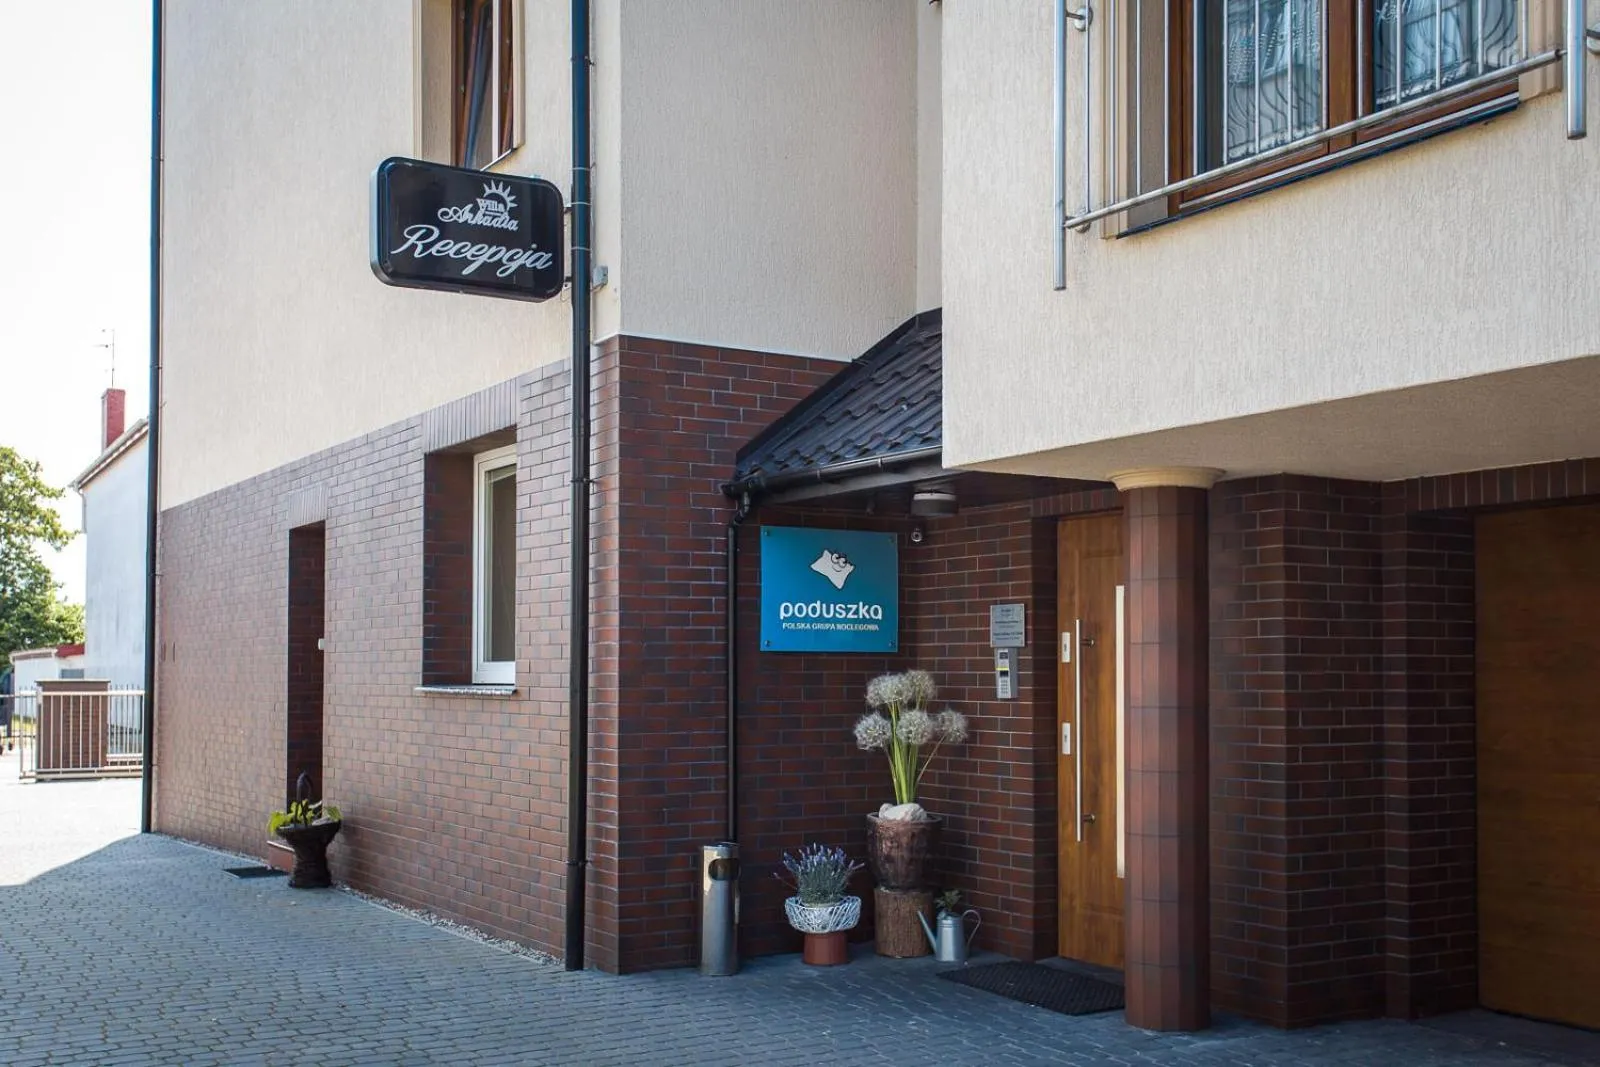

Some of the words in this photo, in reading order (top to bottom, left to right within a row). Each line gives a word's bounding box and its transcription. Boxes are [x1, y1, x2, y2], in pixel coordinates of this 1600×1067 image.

[437, 203, 519, 231] Arkadia
[390, 224, 553, 277] Recepcja
[780, 600, 883, 620] poduszka
[782, 622, 811, 630] POLSKA
[812, 622, 836, 631] GRUPA
